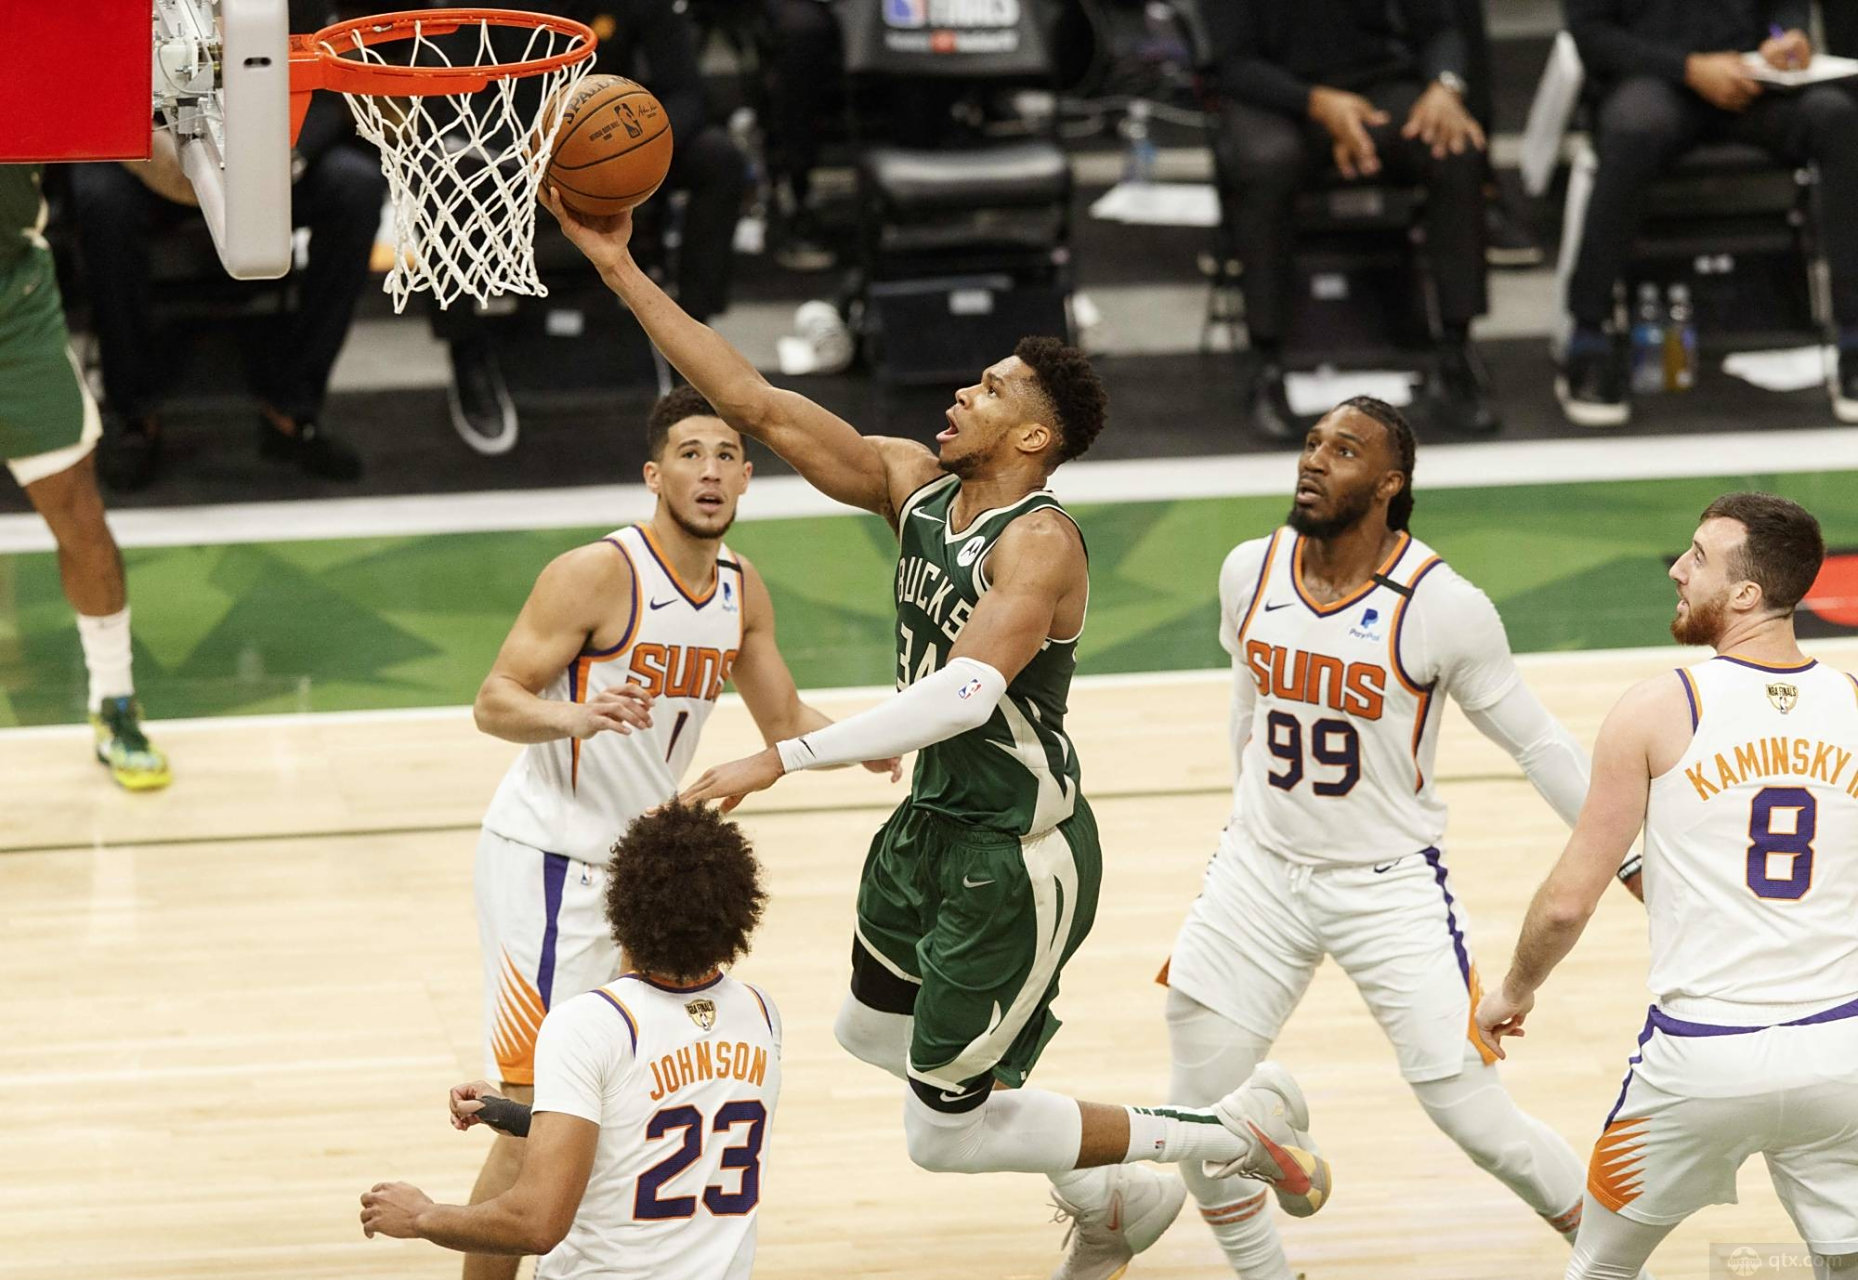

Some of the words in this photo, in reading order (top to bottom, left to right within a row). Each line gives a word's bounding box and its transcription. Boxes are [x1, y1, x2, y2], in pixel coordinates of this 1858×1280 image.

[898, 556, 975, 642] BUCKS
[897, 622, 938, 692] 34
[1246, 639, 1386, 721] SUNS
[1767, 686, 1778, 696] NBA
[1778, 686, 1797, 697] FINALS
[665, 711, 688, 763] 1
[1267, 709, 1361, 797] 99
[1685, 737, 1852, 801] KAMINSKY
[1745, 784, 1818, 902] 8
[650, 1041, 767, 1100] JOHNSON
[633, 1099, 767, 1221] 23
